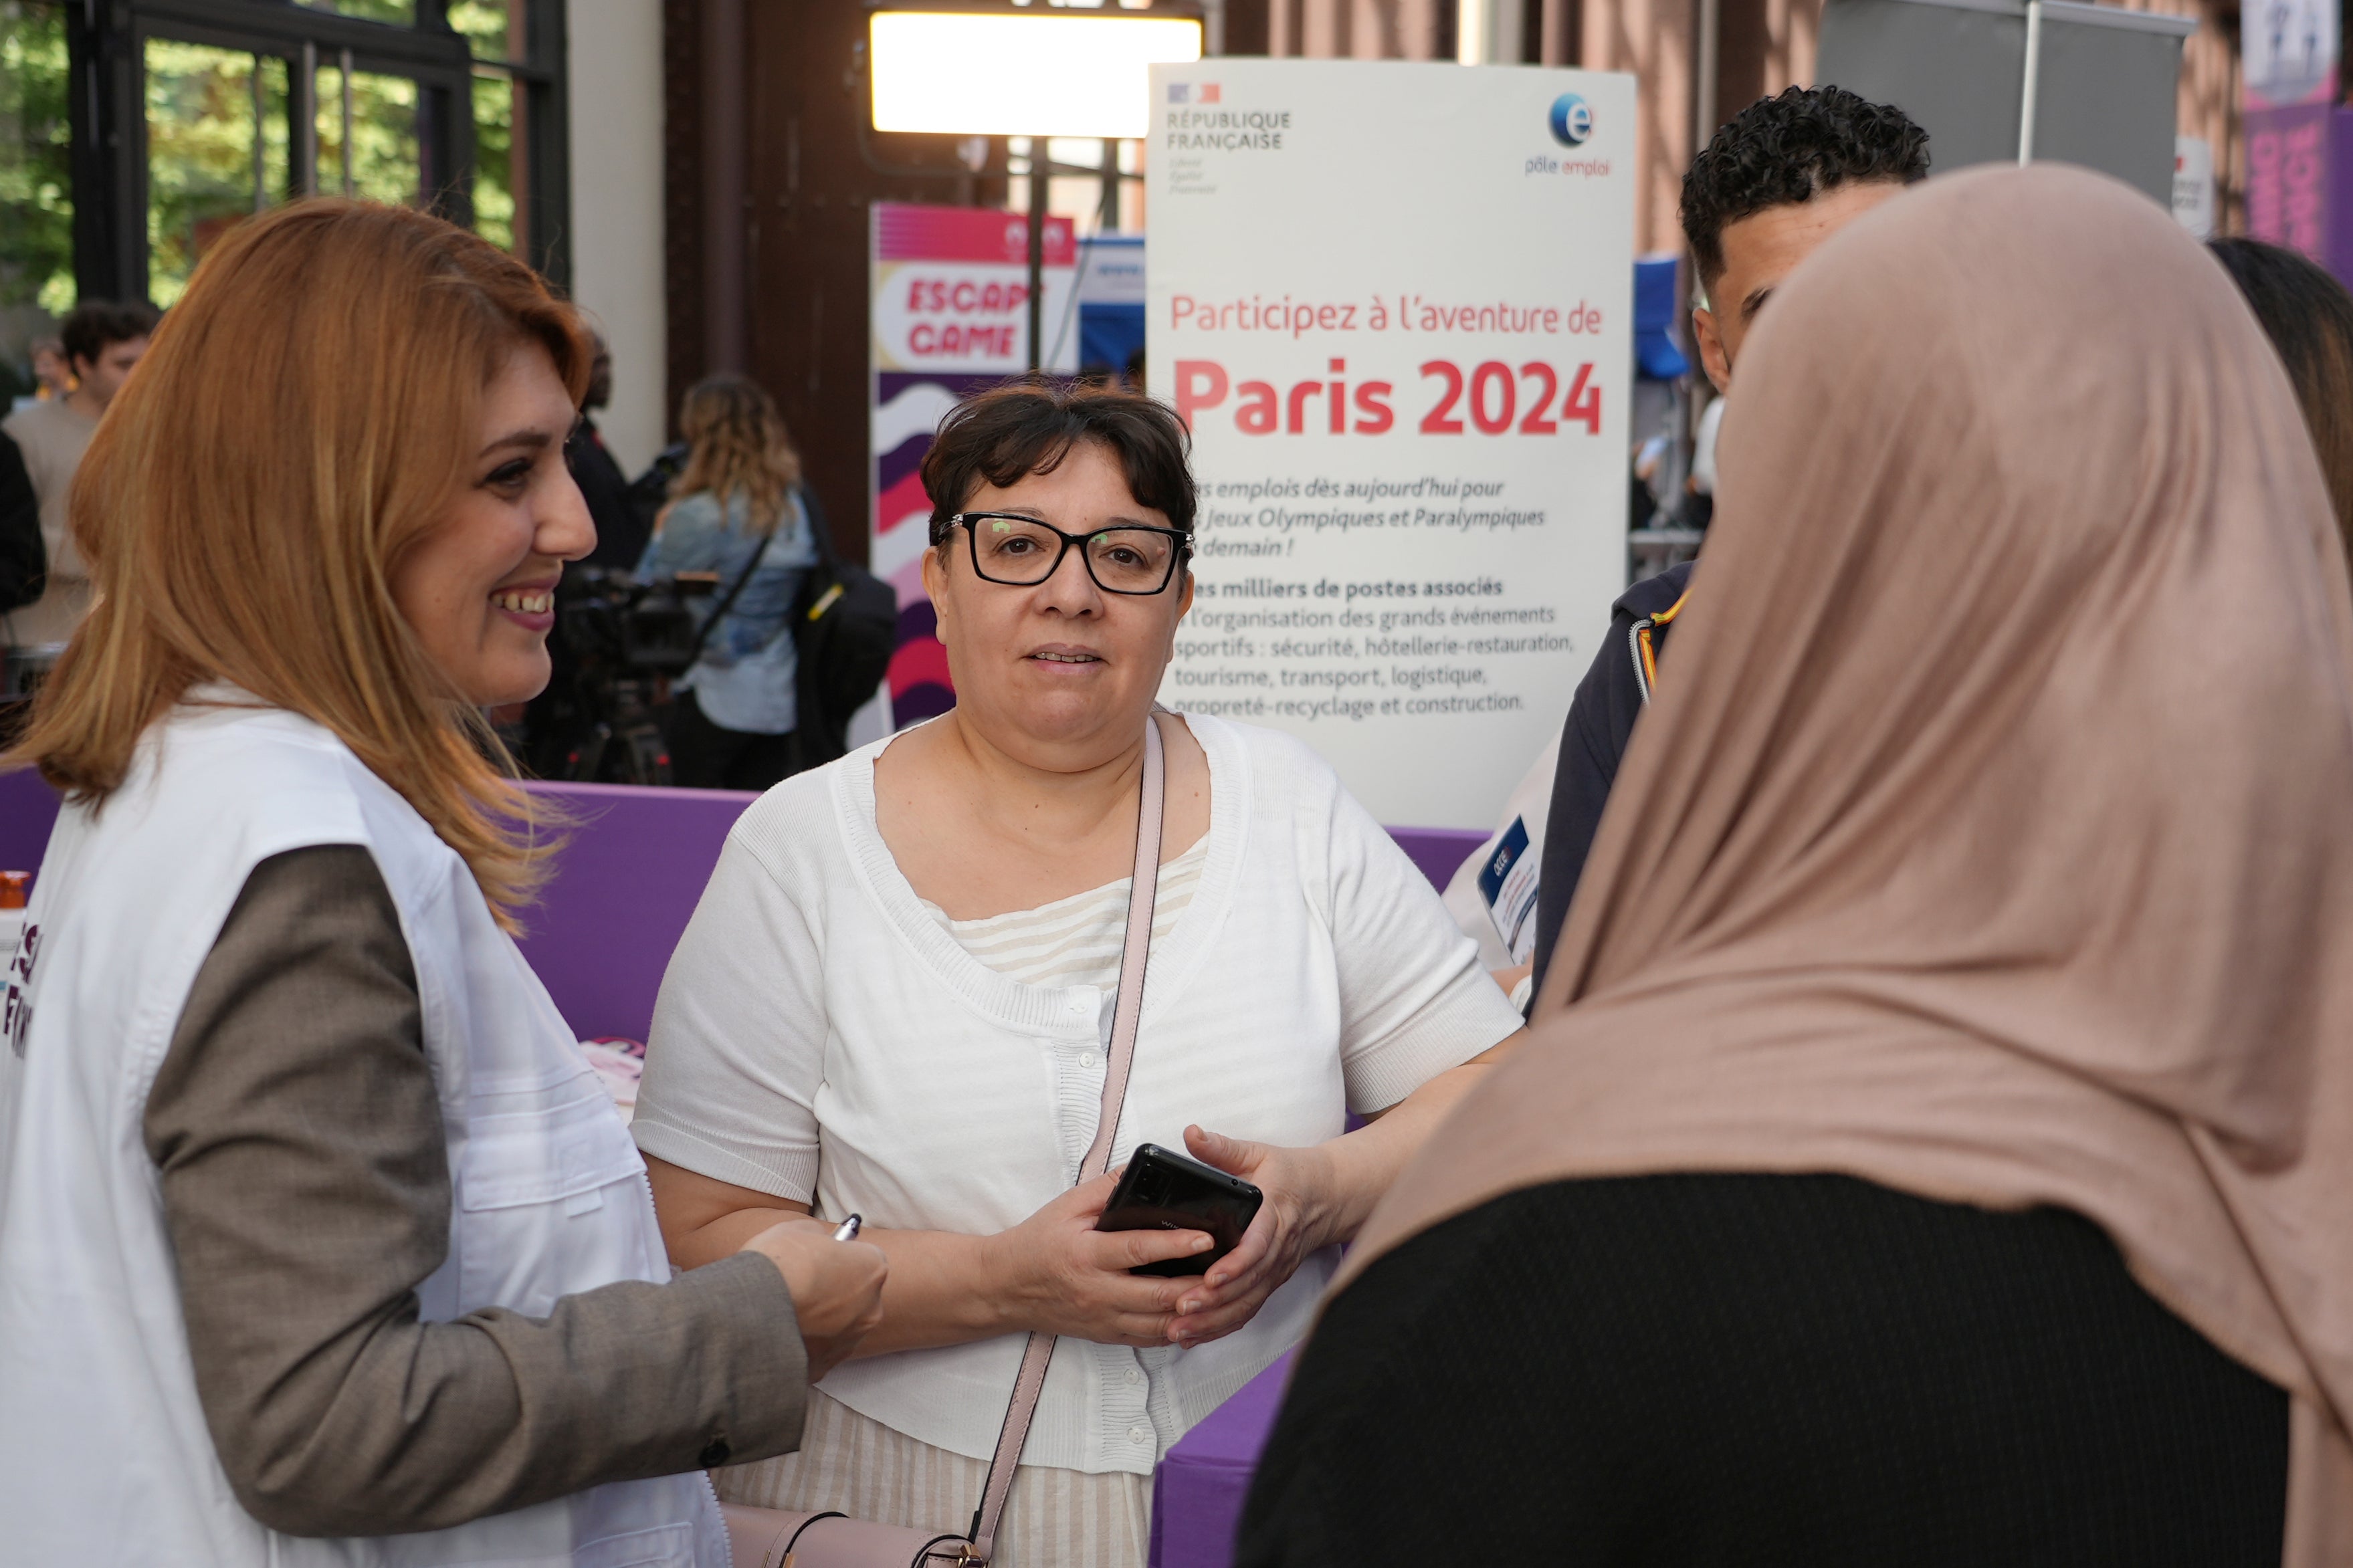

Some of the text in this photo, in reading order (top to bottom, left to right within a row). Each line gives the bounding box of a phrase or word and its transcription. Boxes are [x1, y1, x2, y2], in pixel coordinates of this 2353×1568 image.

[1168, 110, 1290, 132] RÉPUBLIQUE
[1168, 134, 1282, 152] FRANÇAISE
[1525, 156, 1612, 179] pôle emploi
[908, 278, 1045, 314] ESCAP
[1171, 296, 1602, 339] Participez à l'aventure de
[909, 324, 1016, 358] GAME
[1174, 358, 1601, 436] Paris 2024
[1216, 478, 1300, 501] emplois
[1305, 478, 1338, 497] dès
[1344, 477, 1458, 503] aujourd'hui
[1460, 482, 1503, 501] pour
[1205, 509, 1251, 529] Jeux
[1257, 508, 1384, 532] Olympiques
[1389, 511, 1409, 526] et
[1413, 508, 1545, 532] Paralympiques
[1204, 539, 1281, 556] demain
[1286, 539, 1294, 556] !
[1194, 578, 1504, 602] es milliers de postes associés
[1191, 608, 1332, 632] l'organisation
[1338, 608, 1373, 627] des
[1379, 606, 1445, 633] grands
[1450, 606, 1555, 626] événements
[1175, 637, 1254, 662] sportifs
[1271, 637, 1360, 659] sécurité,
[1365, 635, 1574, 657] hôtellerie-restauration,
[1175, 667, 1488, 692] tourisme, transport, logistique,
[1174, 694, 1524, 720] propreté-recyclage et construction.
